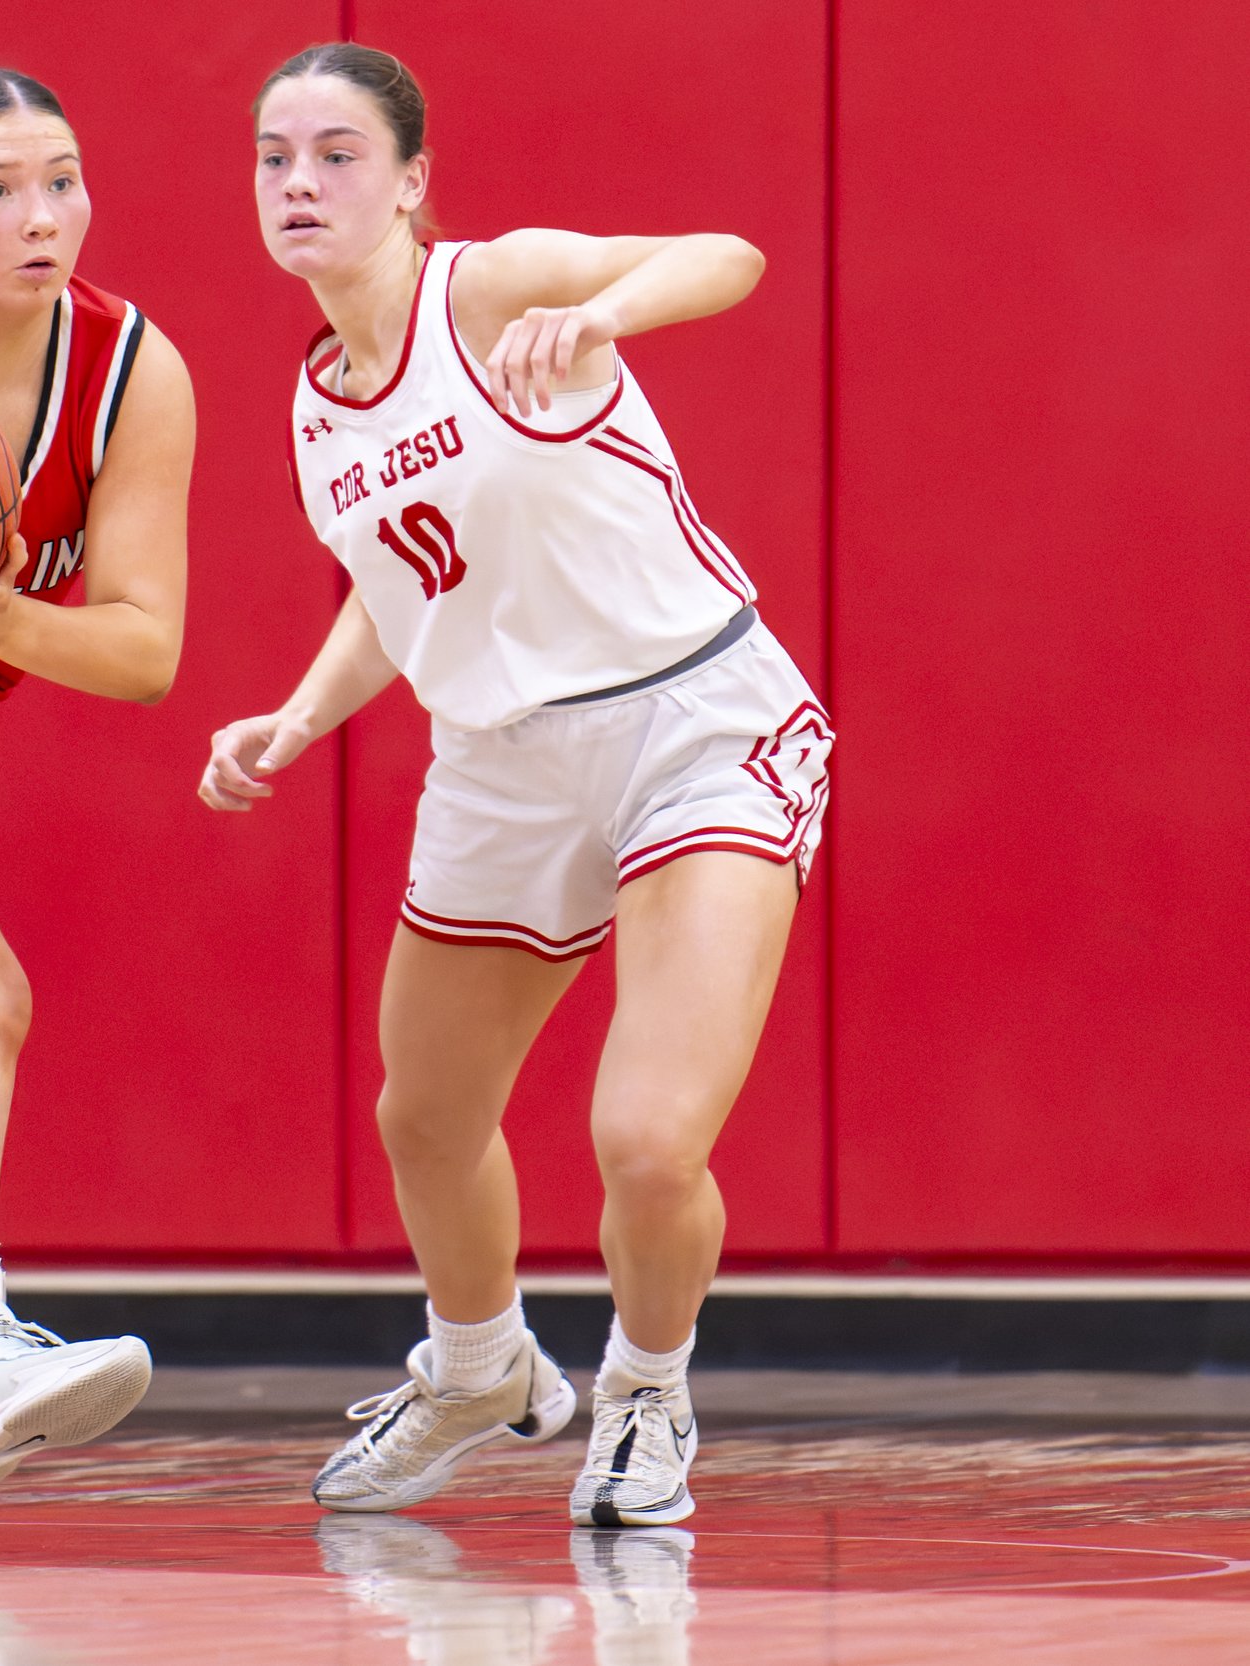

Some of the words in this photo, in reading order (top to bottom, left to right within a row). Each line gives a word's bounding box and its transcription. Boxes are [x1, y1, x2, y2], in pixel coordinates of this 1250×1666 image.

[330, 461, 371, 516] COR
[379, 415, 465, 489] JESU
[377, 501, 468, 601] 10
